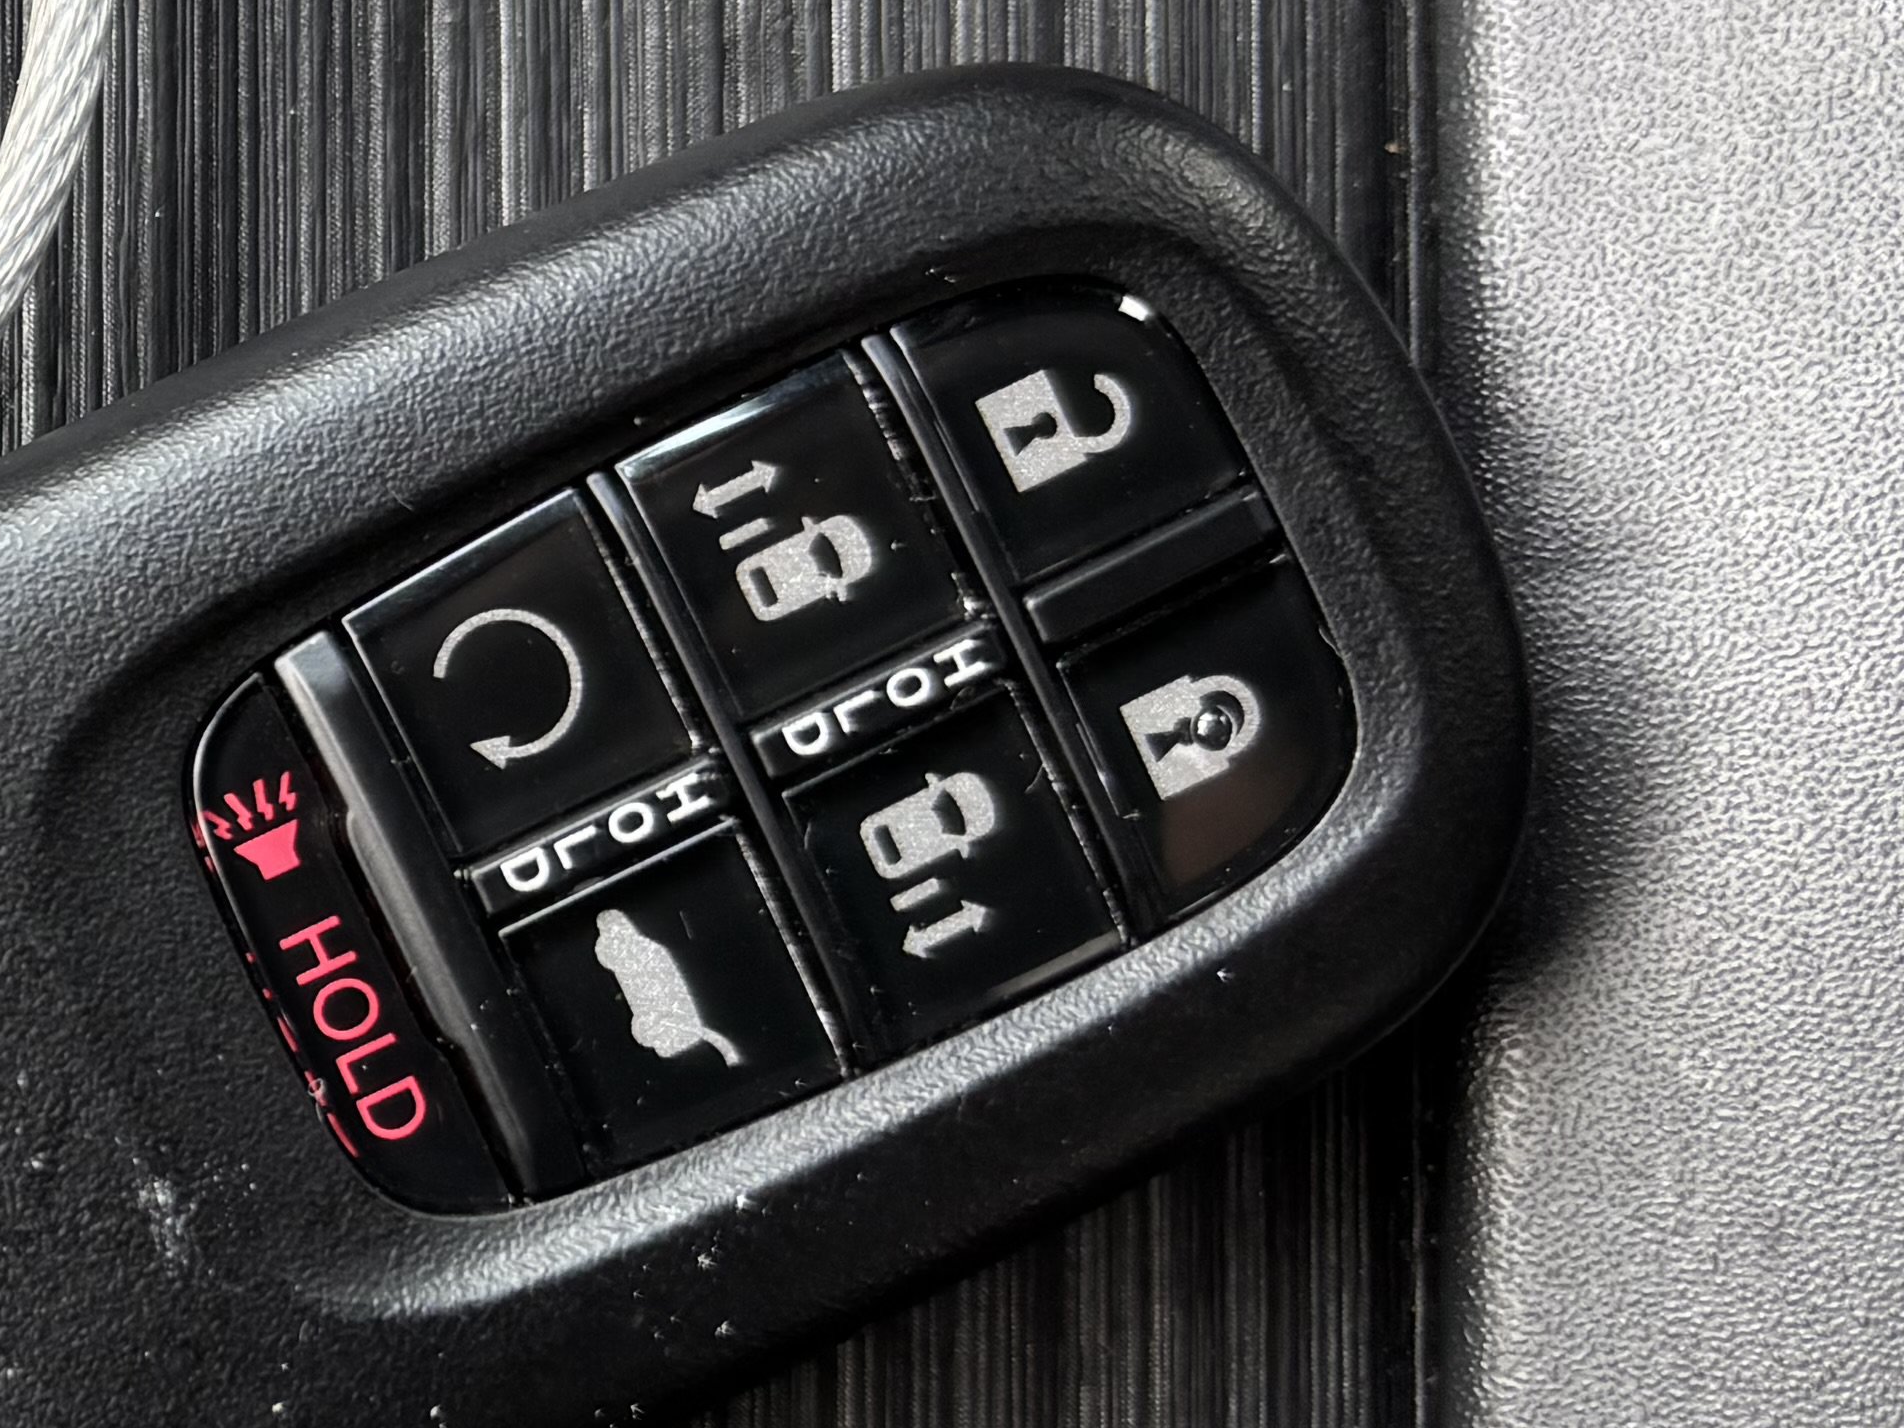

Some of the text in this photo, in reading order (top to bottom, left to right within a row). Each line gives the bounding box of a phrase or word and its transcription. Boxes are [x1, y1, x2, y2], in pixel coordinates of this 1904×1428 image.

[782, 638, 991, 756] HOLD
[500, 769, 712, 893] HOLD
[278, 914, 427, 1140] HOLD
